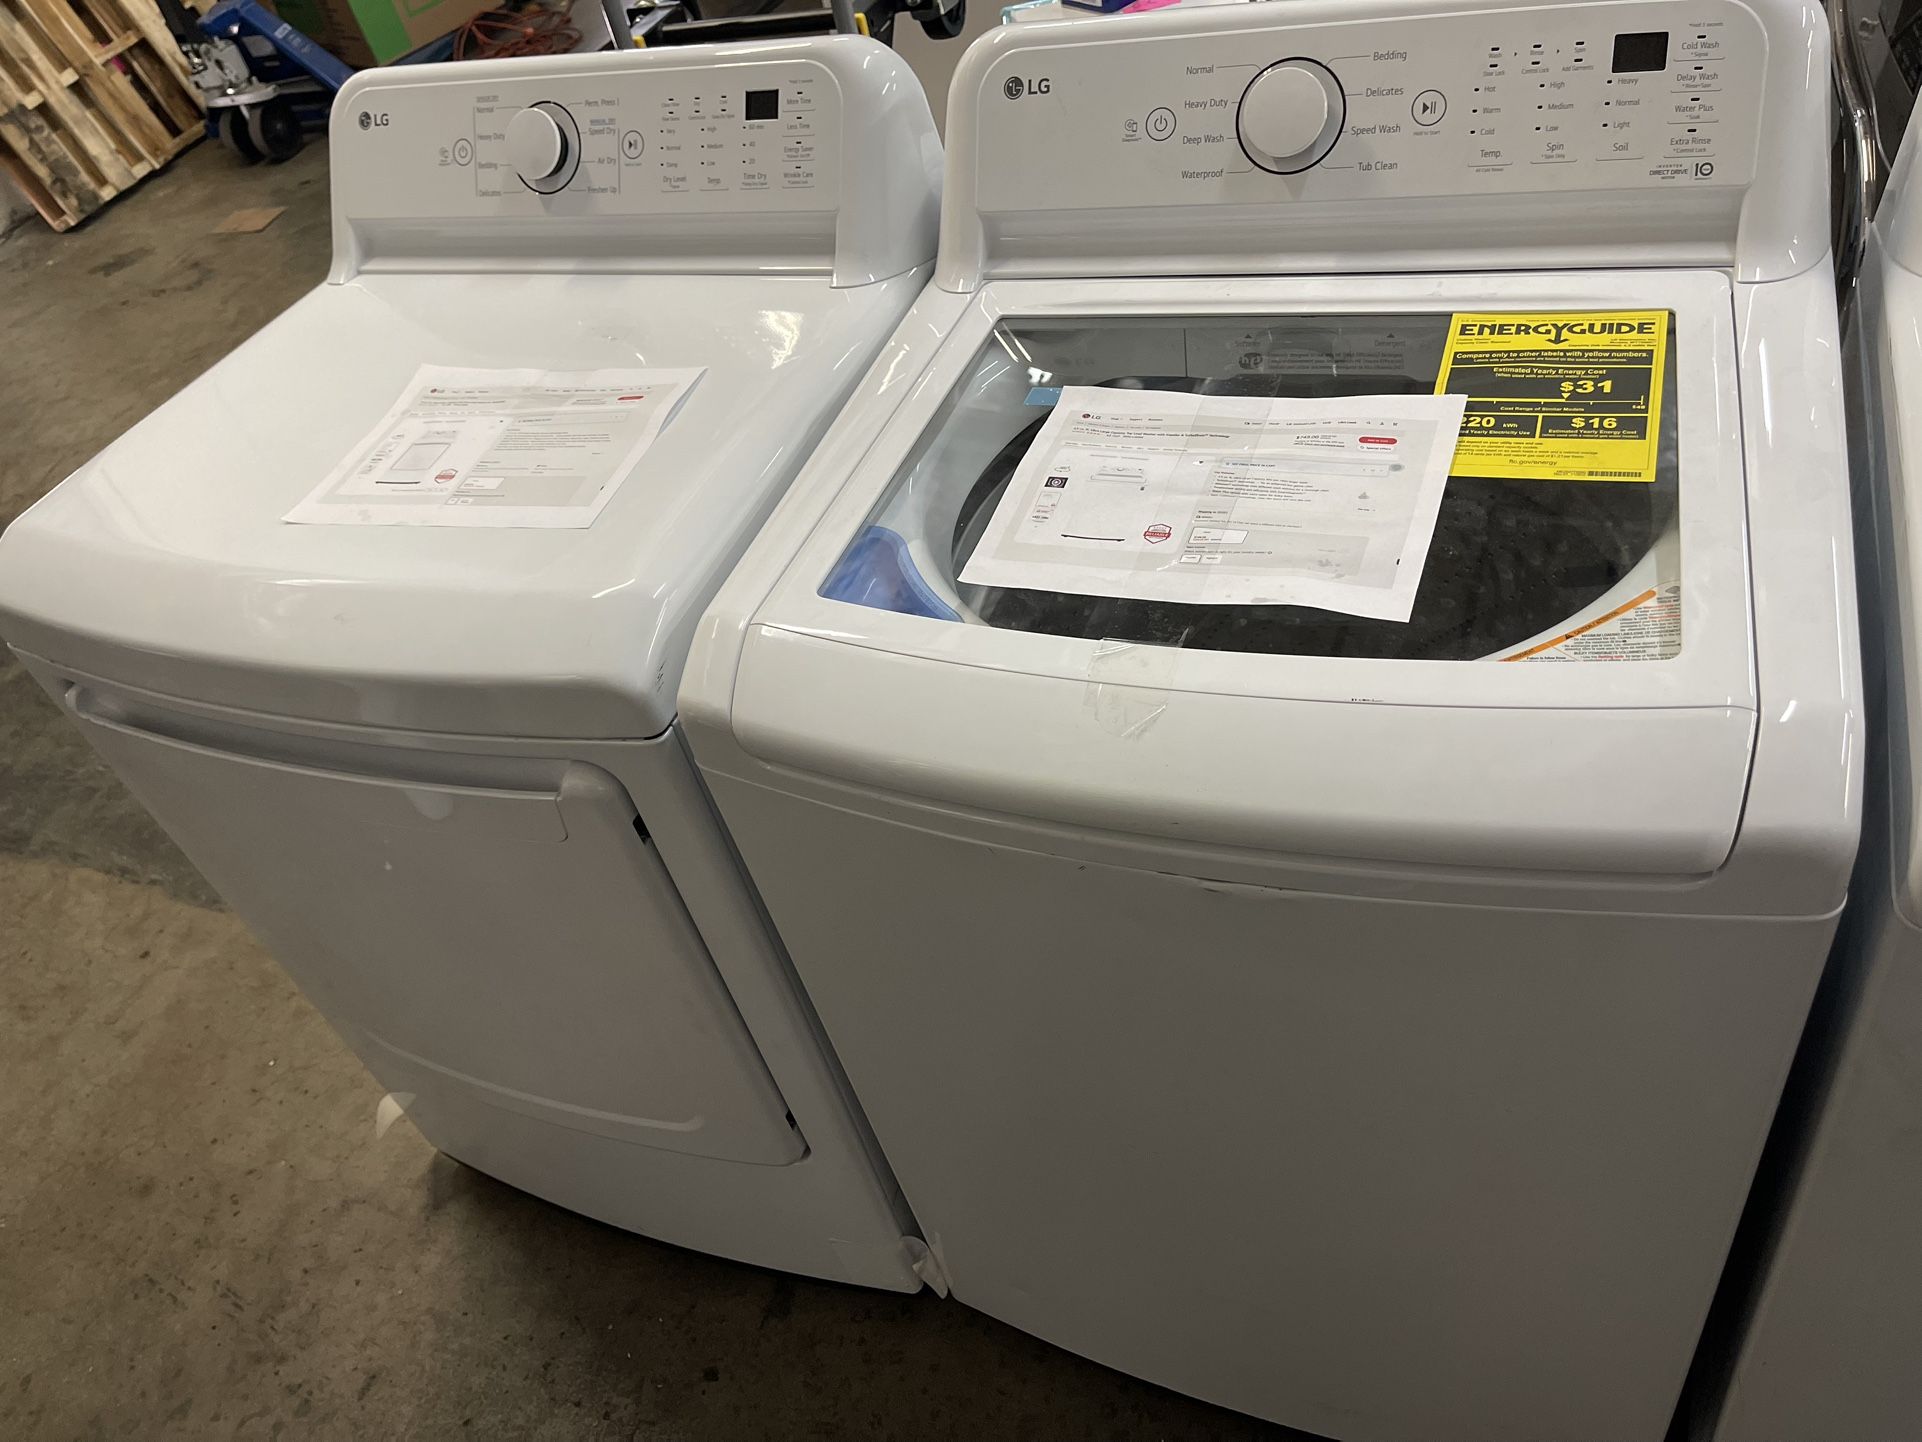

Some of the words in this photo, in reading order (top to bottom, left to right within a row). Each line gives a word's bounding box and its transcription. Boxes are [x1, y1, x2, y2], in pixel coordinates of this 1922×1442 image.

[1682, 42, 1698, 50] Cold
[1700, 41, 1720, 49] Wash
[1373, 50, 1407, 62] Bedding
[1186, 65, 1214, 75] Normal
[1618, 78, 1638, 86] Heavy
[1676, 74, 1697, 83] Delay
[1028, 78, 1050, 95] LG
[1366, 87, 1404, 98] Delicates
[1185, 100, 1207, 110] Heavy
[1210, 99, 1228, 108] Duty
[1674, 104, 1696, 112] Water
[374, 114, 389, 126] LG
[1351, 126, 1377, 136] Speed
[1379, 125, 1400, 134] Wash
[1613, 122, 1630, 130] Light
[606, 127, 616, 136] Dry
[1183, 135, 1201, 145] Deep
[1204, 134, 1224, 143] Wash
[1546, 142, 1564, 152] Spin
[1613, 142, 1629, 152] Soil
[1480, 150, 1503, 159] Temp.
[1358, 162, 1372, 172] Tub
[1374, 161, 1398, 170] Clean
[1182, 169, 1224, 179] Waterproof
[1459, 322, 1655, 342] ENERGYGUIDE
[1560, 380, 1612, 393] $31
[1571, 417, 1617, 428] $16
